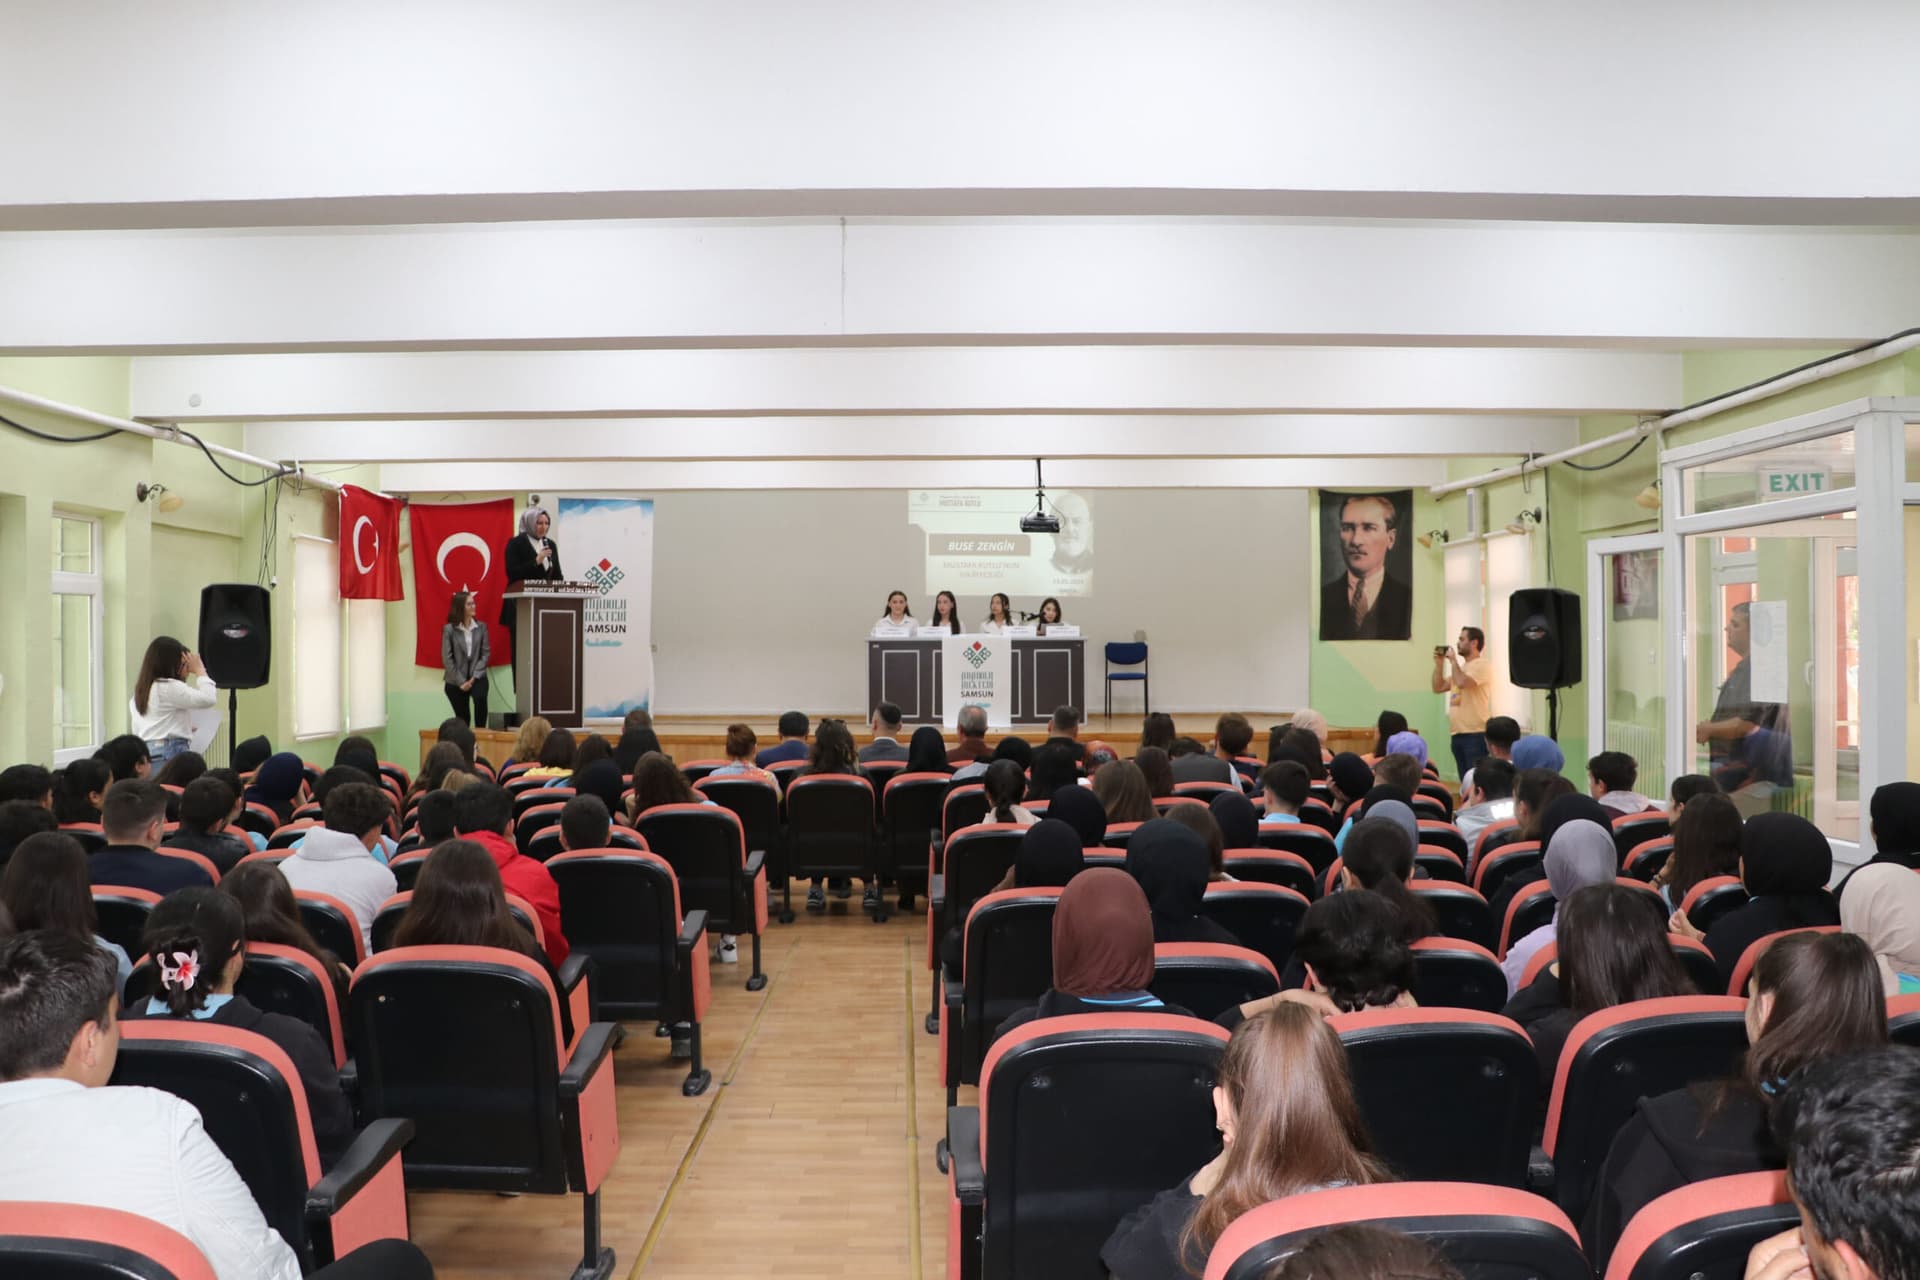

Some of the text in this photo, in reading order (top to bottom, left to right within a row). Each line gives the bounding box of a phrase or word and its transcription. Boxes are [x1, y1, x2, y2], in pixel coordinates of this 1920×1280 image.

[1769, 473, 1824, 492] EXIT
[948, 540, 1015, 552] BUSE ZENGİN
[960, 690, 994, 698] SAMSUN
